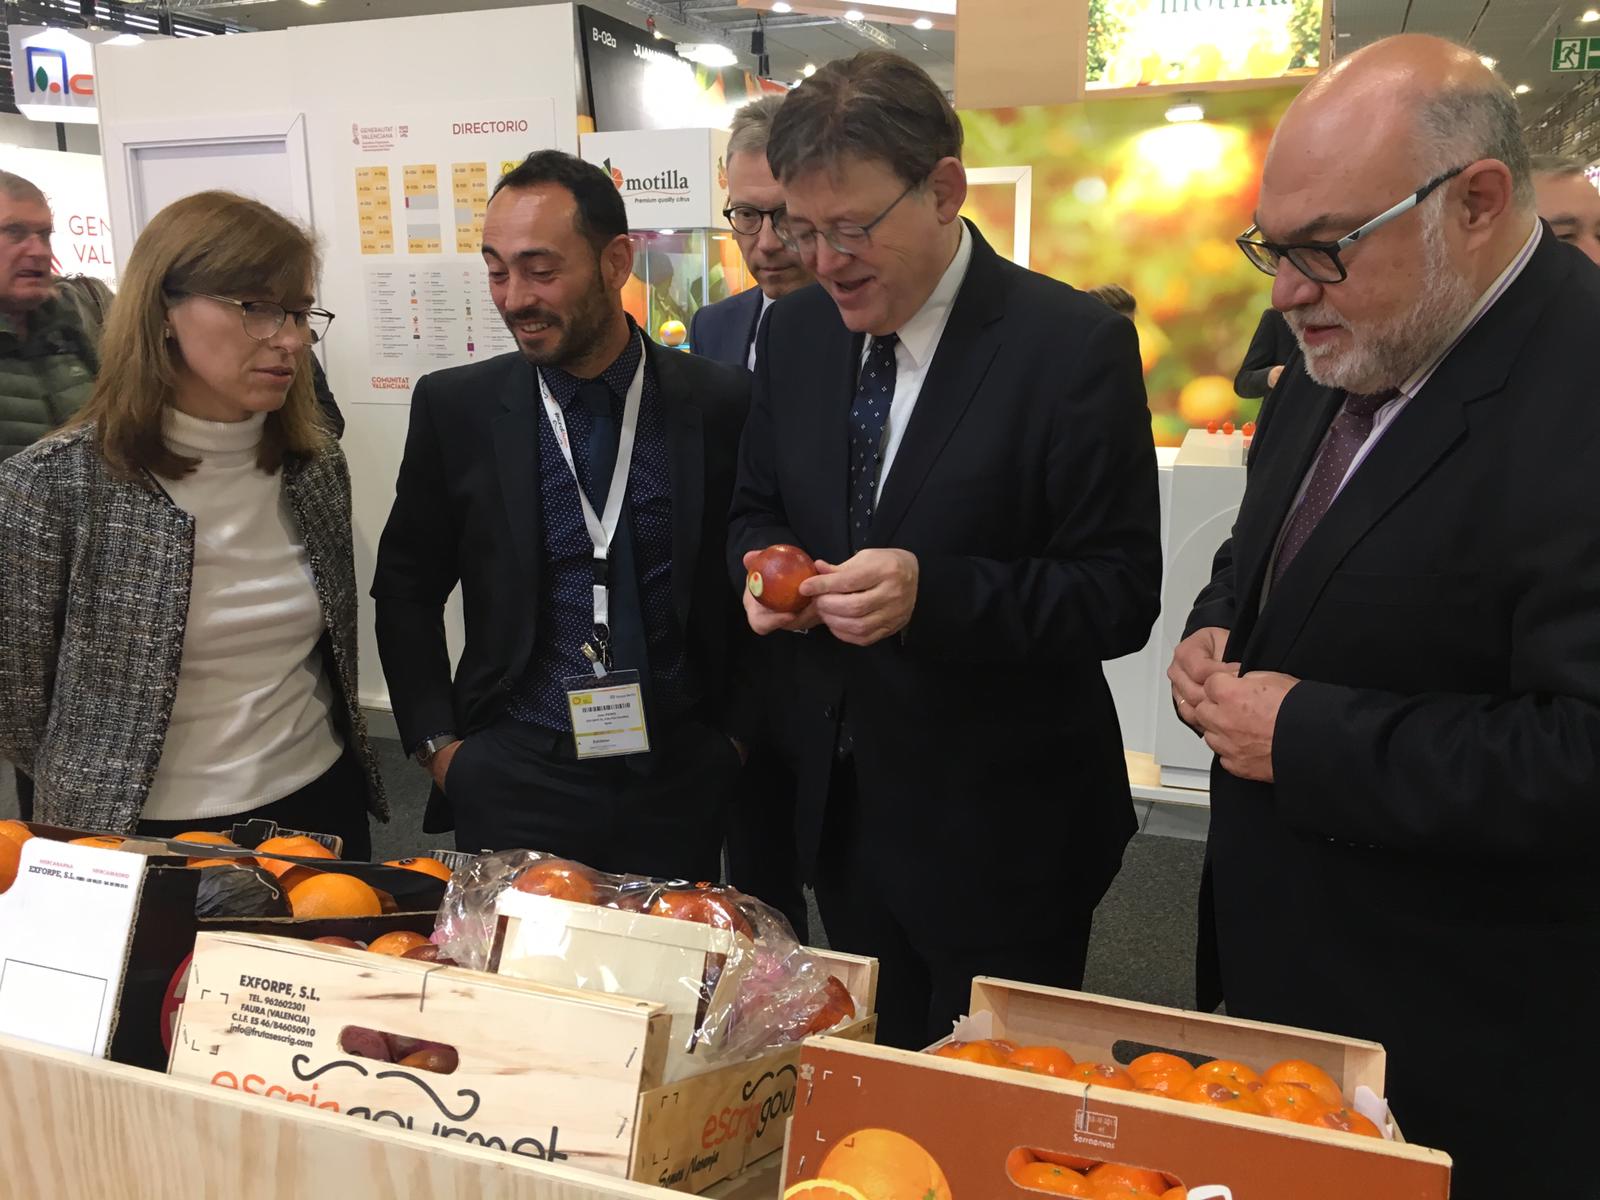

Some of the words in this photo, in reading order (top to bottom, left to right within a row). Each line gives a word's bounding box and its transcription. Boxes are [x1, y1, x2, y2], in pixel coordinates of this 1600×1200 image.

[592, 27, 617, 48] B-02a
[452, 120, 528, 135] DIRECTORIO
[626, 170, 689, 190] motilla
[371, 376, 410, 384] COMUNITAT
[372, 382, 411, 390] VALENCIANA
[240, 974, 295, 998] EXFORPE,
[298, 986, 321, 1002] S.L.
[248, 993, 264, 1004] TEL.
[264, 995, 306, 1012] 962602301
[240, 1003, 266, 1017] FAURA
[266, 1008, 311, 1025] (VALENCIA)
[250, 1016, 260, 1026] ES
